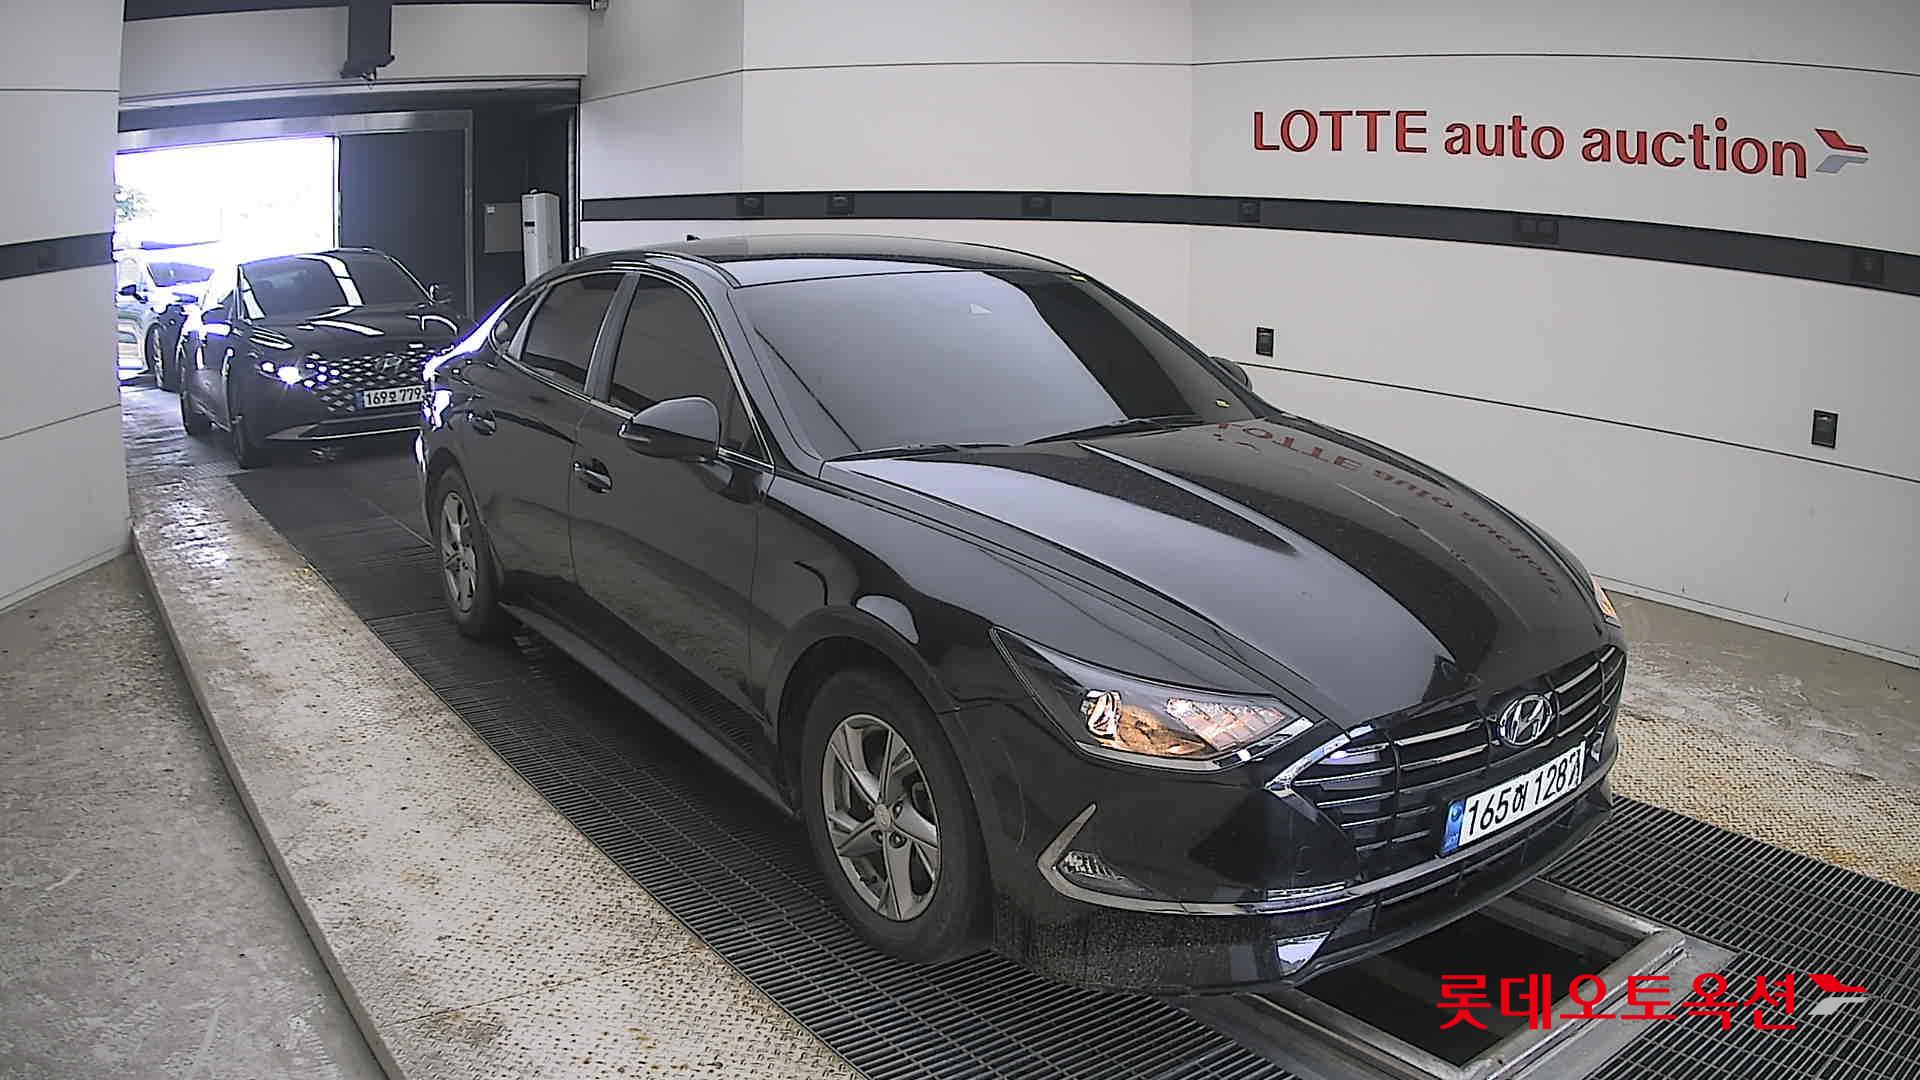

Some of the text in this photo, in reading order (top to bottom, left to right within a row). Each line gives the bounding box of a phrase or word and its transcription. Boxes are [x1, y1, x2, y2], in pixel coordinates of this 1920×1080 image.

[1253, 109, 1808, 179] LOTTE auto auction
[400, 387, 424, 401] 779
